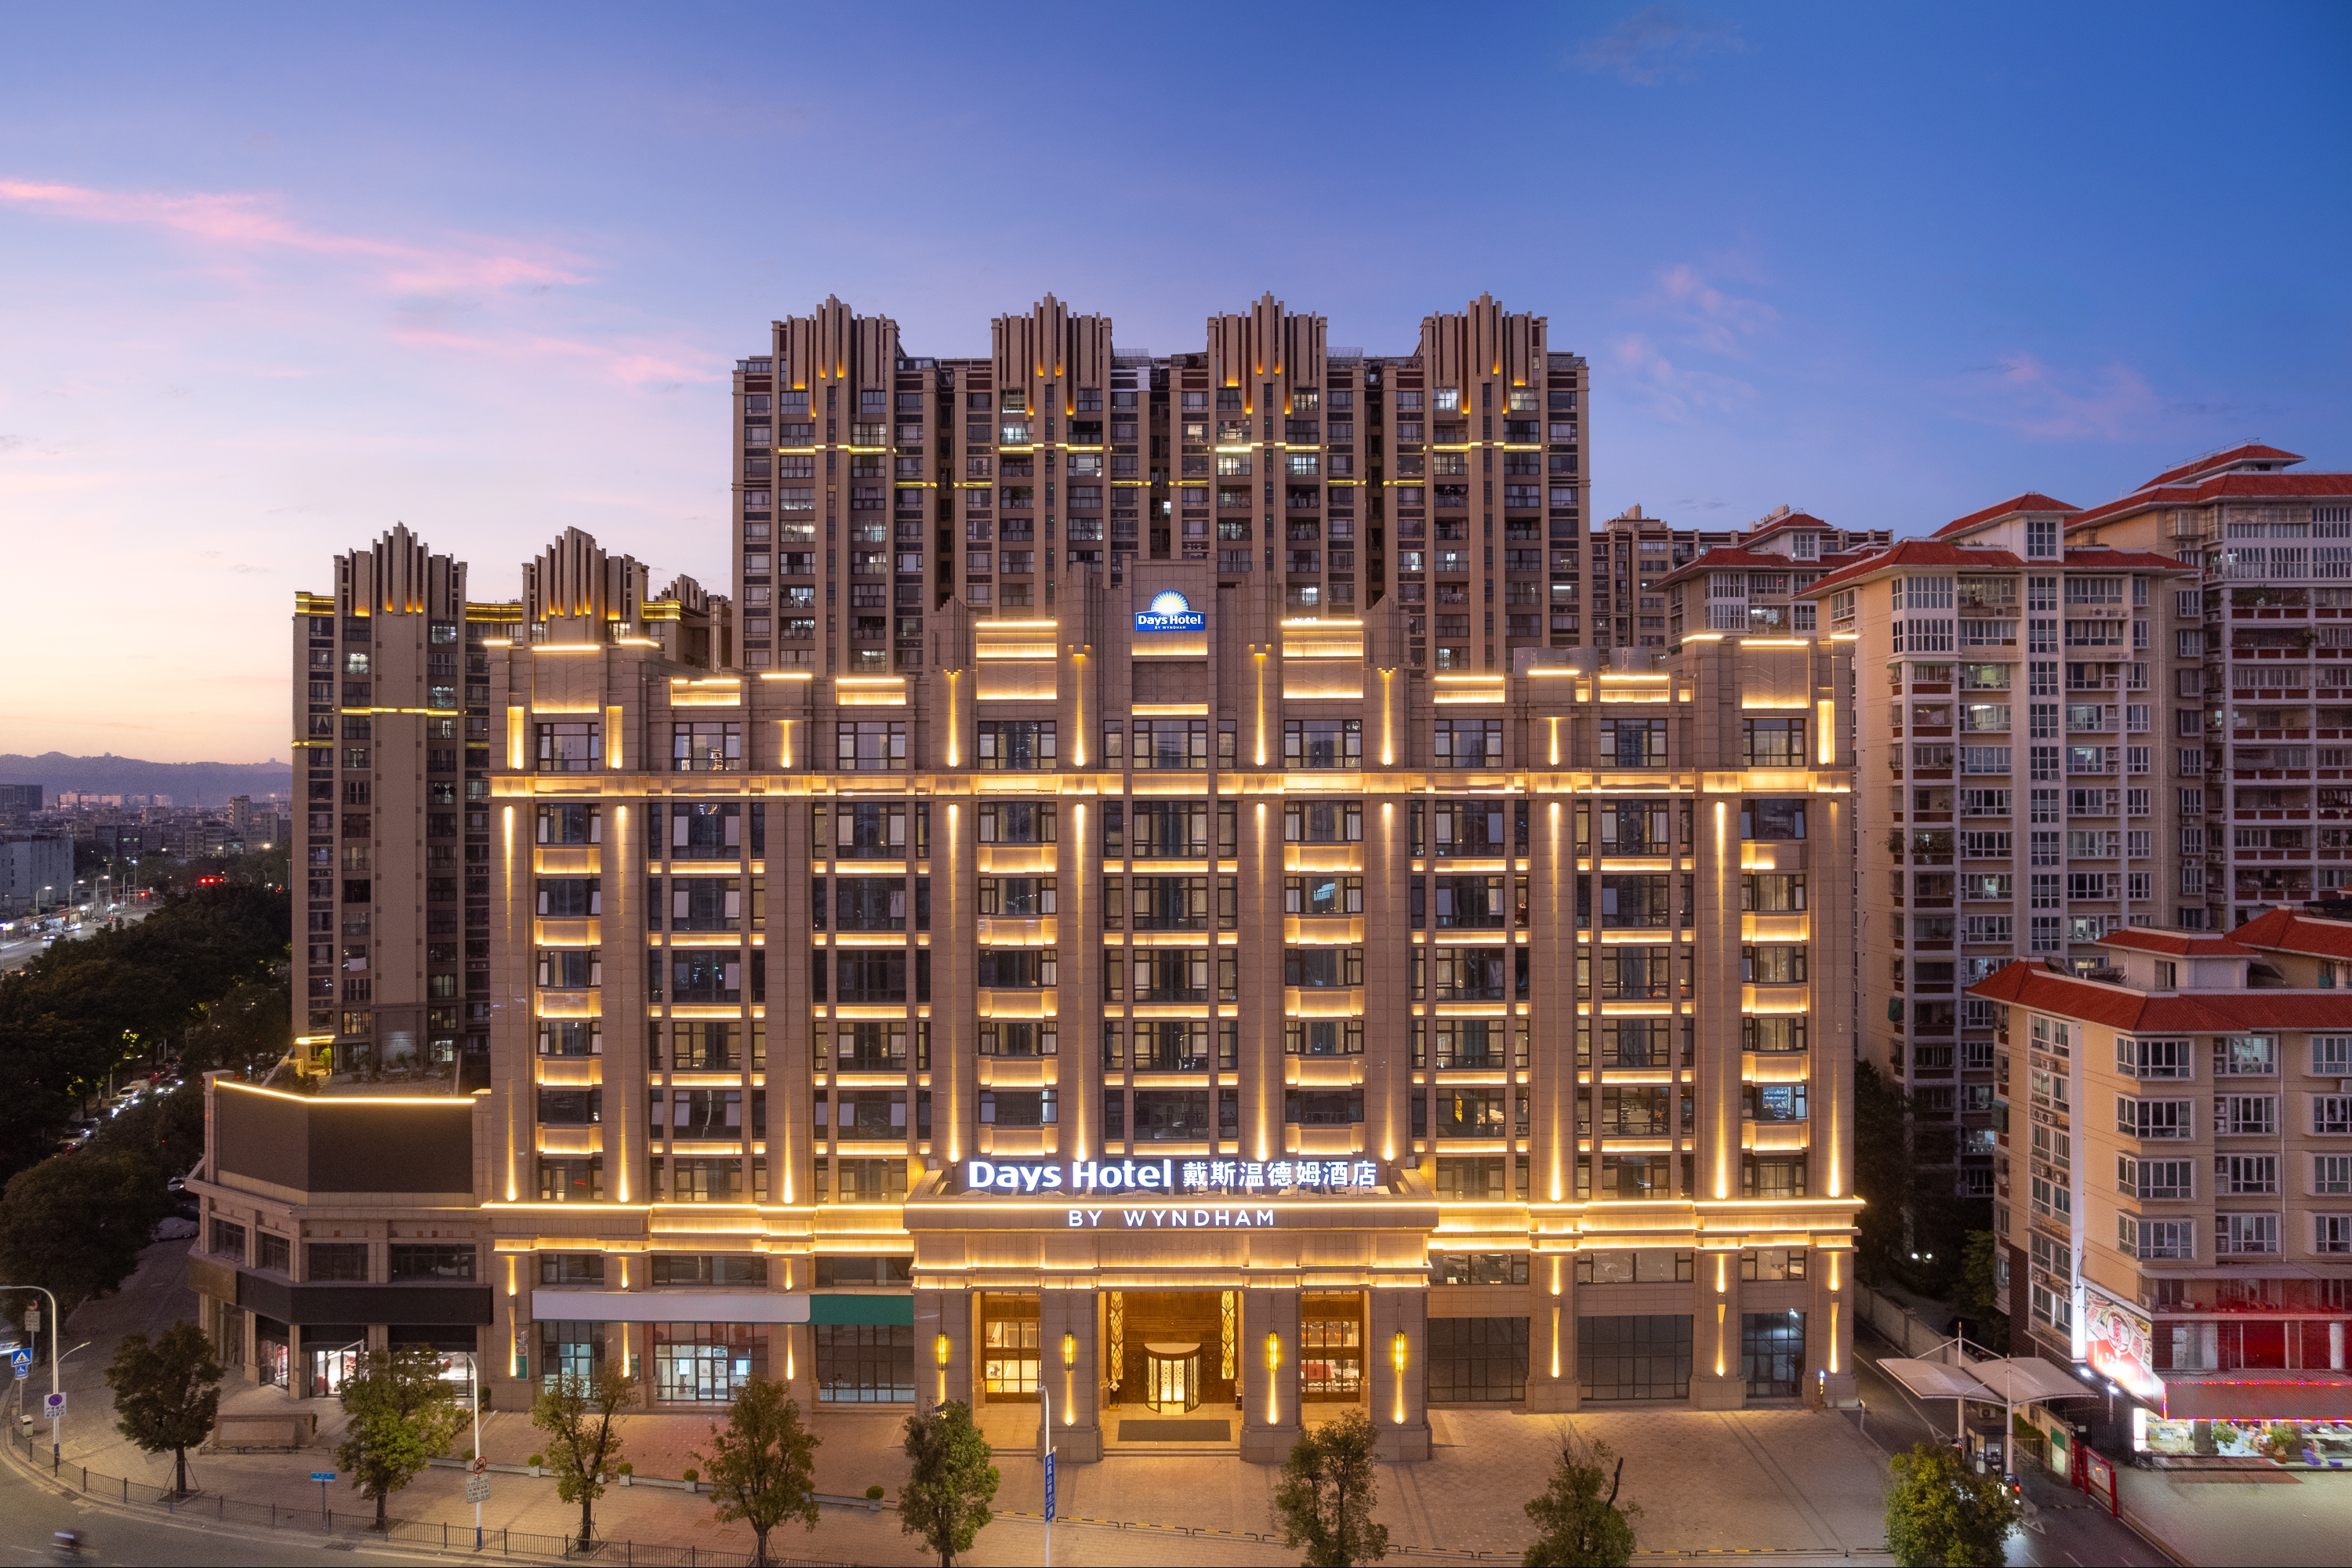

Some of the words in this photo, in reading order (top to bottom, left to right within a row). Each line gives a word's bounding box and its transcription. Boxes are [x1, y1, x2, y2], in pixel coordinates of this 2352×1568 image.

[1138, 615, 1167, 626] Days
[1170, 615, 1200, 624] Hotel
[968, 1161, 1062, 1191] Days
[1072, 1159, 1172, 1188] Hotel
[1182, 1160, 1377, 1187] 戴斯温德姆酒店
[1069, 1210, 1103, 1226] BY
[1123, 1209, 1275, 1227] WYNDHAM
